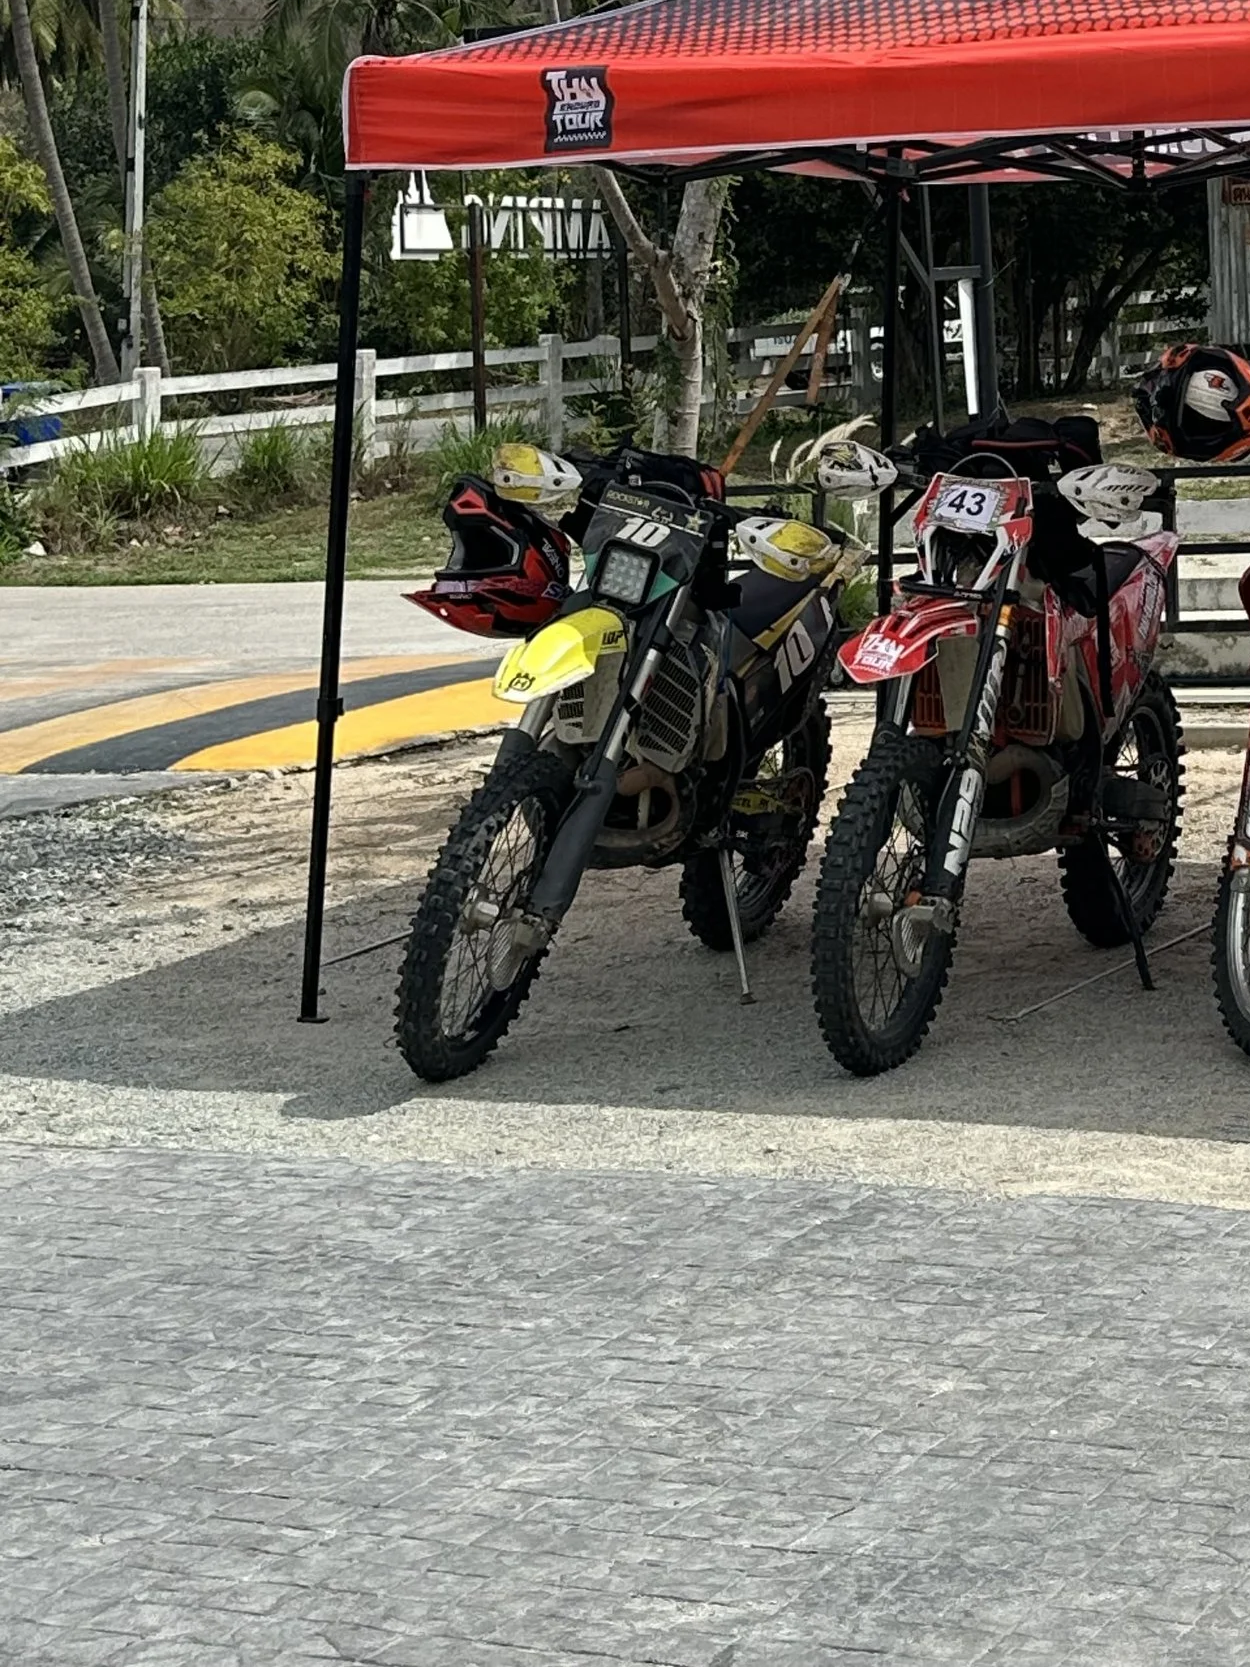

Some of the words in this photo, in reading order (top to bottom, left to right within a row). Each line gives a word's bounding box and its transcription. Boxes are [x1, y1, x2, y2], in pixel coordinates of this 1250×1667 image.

[552, 111, 604, 134] TOUR
[948, 490, 986, 516] 43
[615, 517, 671, 547] 10
[774, 620, 815, 694] 10
